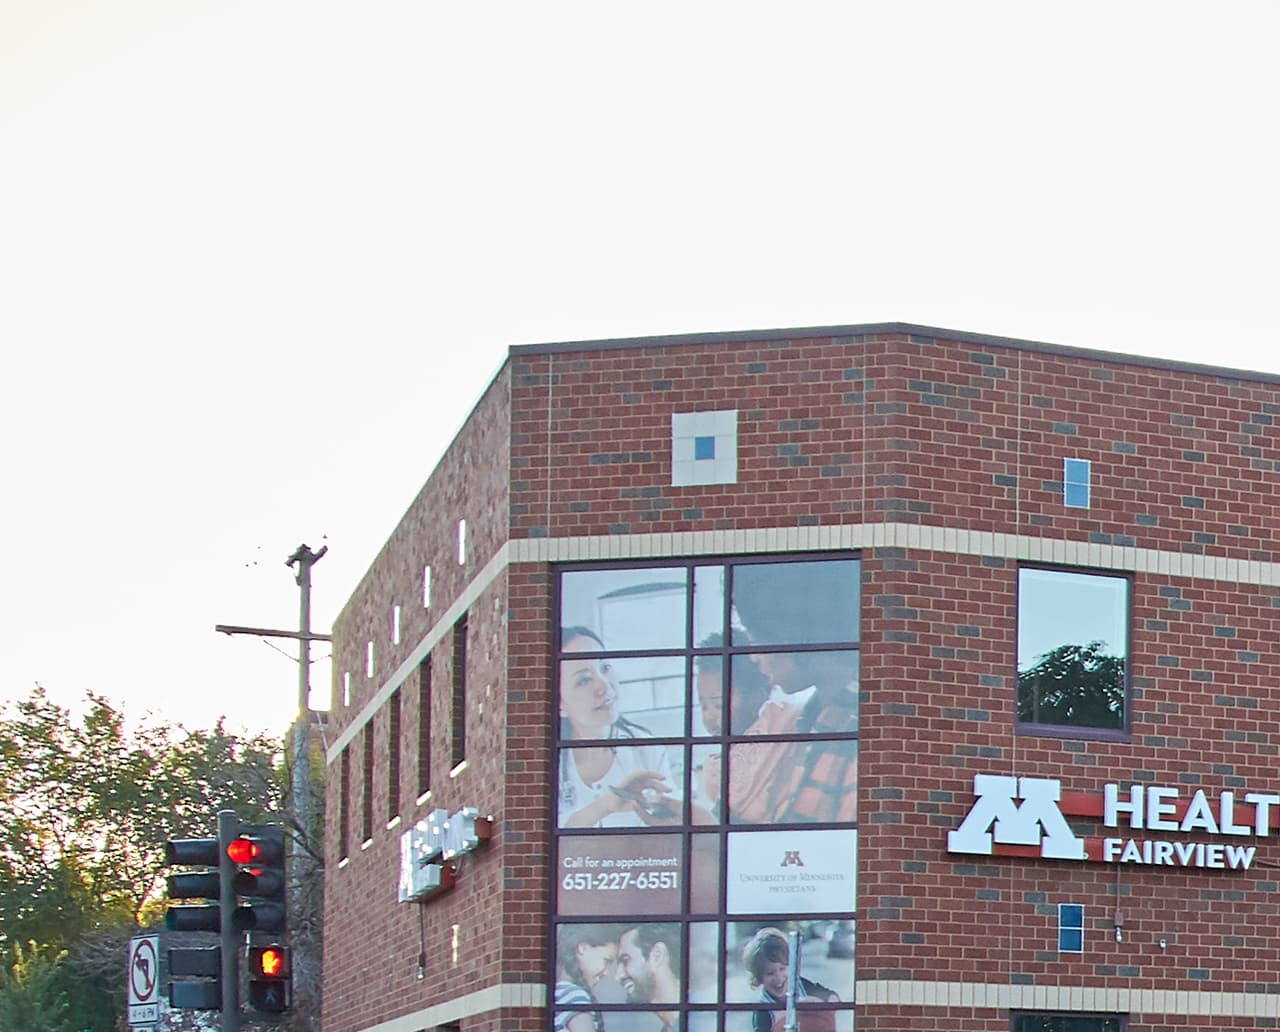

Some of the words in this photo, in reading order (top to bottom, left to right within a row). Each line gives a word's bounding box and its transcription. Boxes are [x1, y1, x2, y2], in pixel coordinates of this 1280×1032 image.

[563, 857, 583, 868] Call
[585, 856, 599, 868] for
[601, 859, 614, 867] an
[615, 857, 678, 870] appointment
[1104, 838, 1256, 870] FAIRVIEW
[562, 871, 678, 890] 651-227-6551
